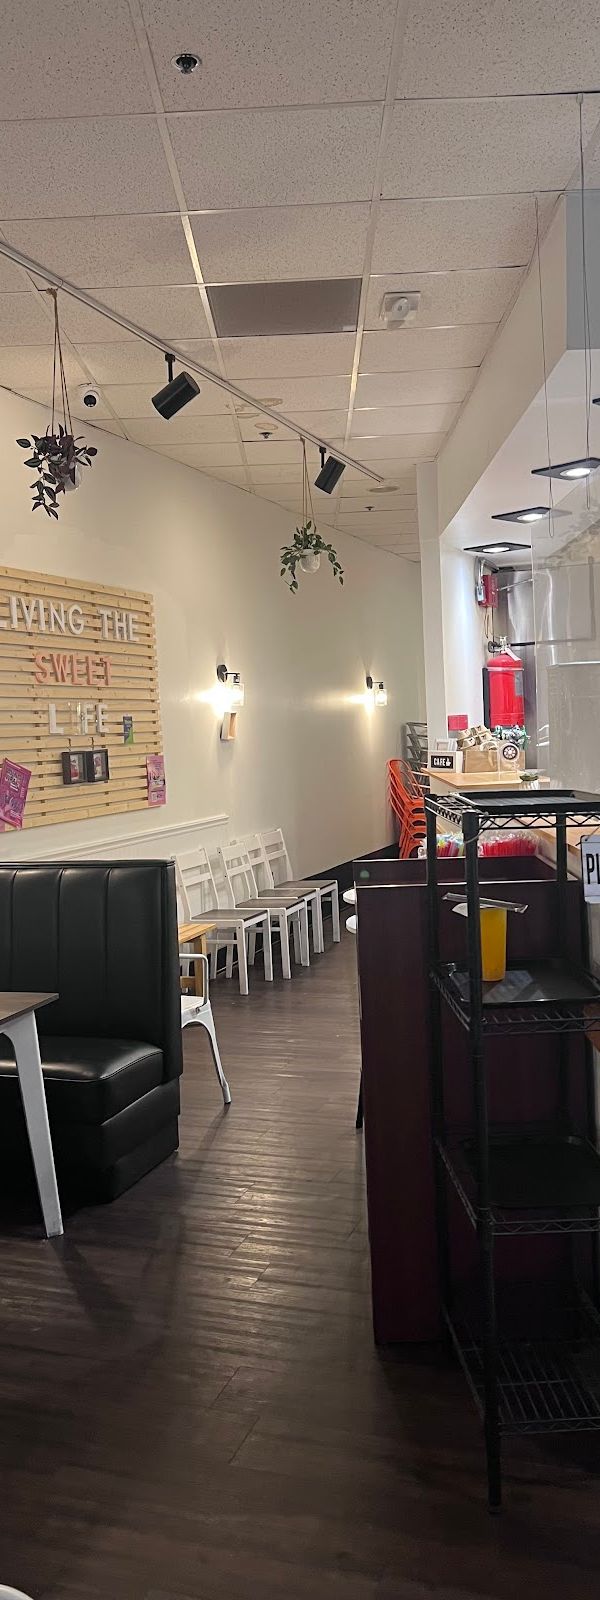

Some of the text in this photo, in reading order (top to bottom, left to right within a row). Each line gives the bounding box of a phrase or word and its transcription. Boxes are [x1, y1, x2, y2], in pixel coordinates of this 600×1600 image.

[98, 608, 139, 642] THE
[34, 652, 112, 686] SWEET
[433, 757, 446, 767] CAFE
